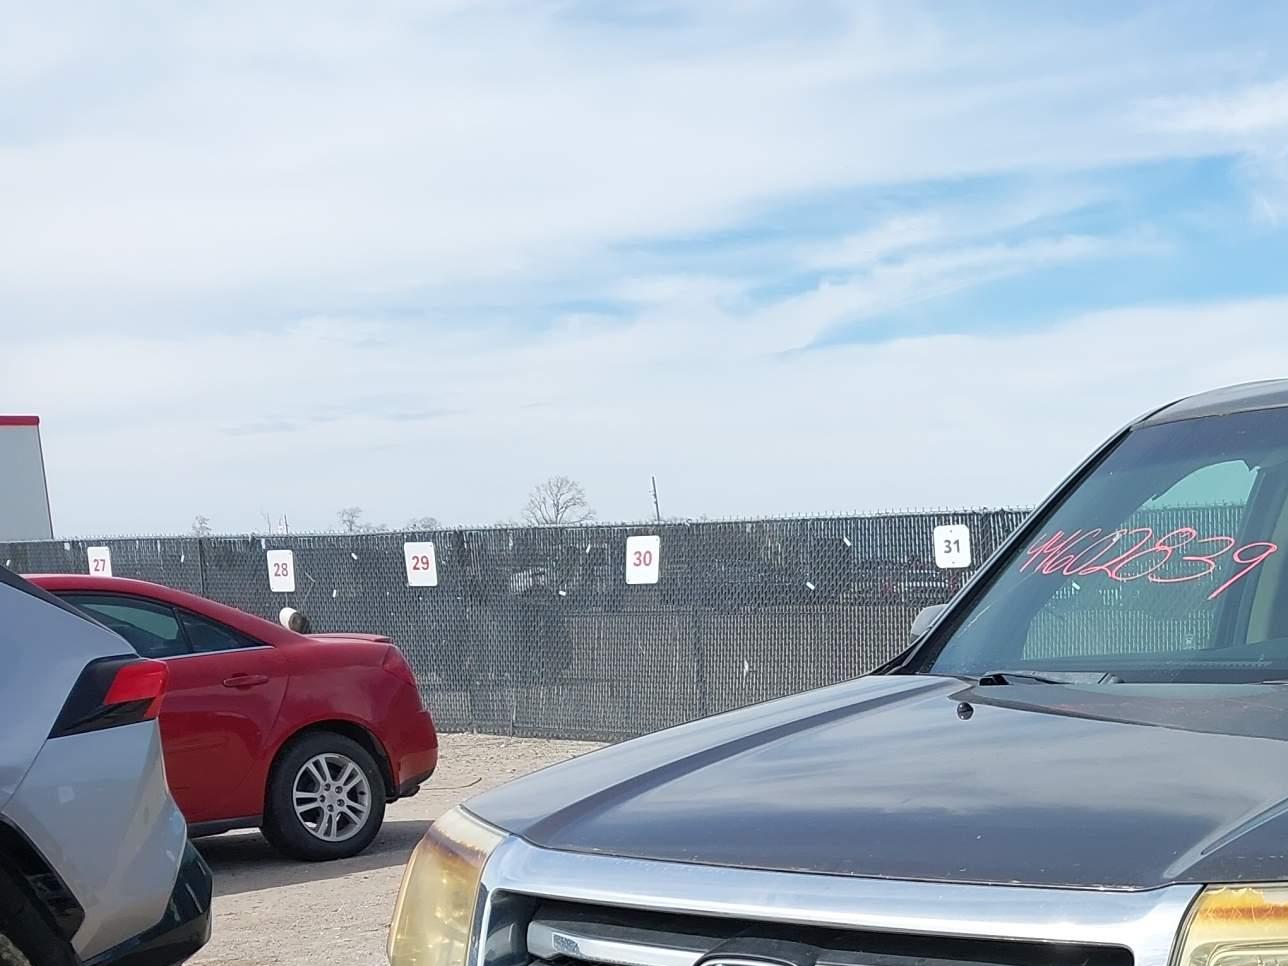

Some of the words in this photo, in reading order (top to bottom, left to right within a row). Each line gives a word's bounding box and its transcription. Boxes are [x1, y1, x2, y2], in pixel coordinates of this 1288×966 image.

[943, 539, 961, 554] 31
[93, 558, 106, 572] 27
[411, 555, 430, 571] 29
[632, 550, 653, 567] 30
[273, 562, 289, 577] 28
